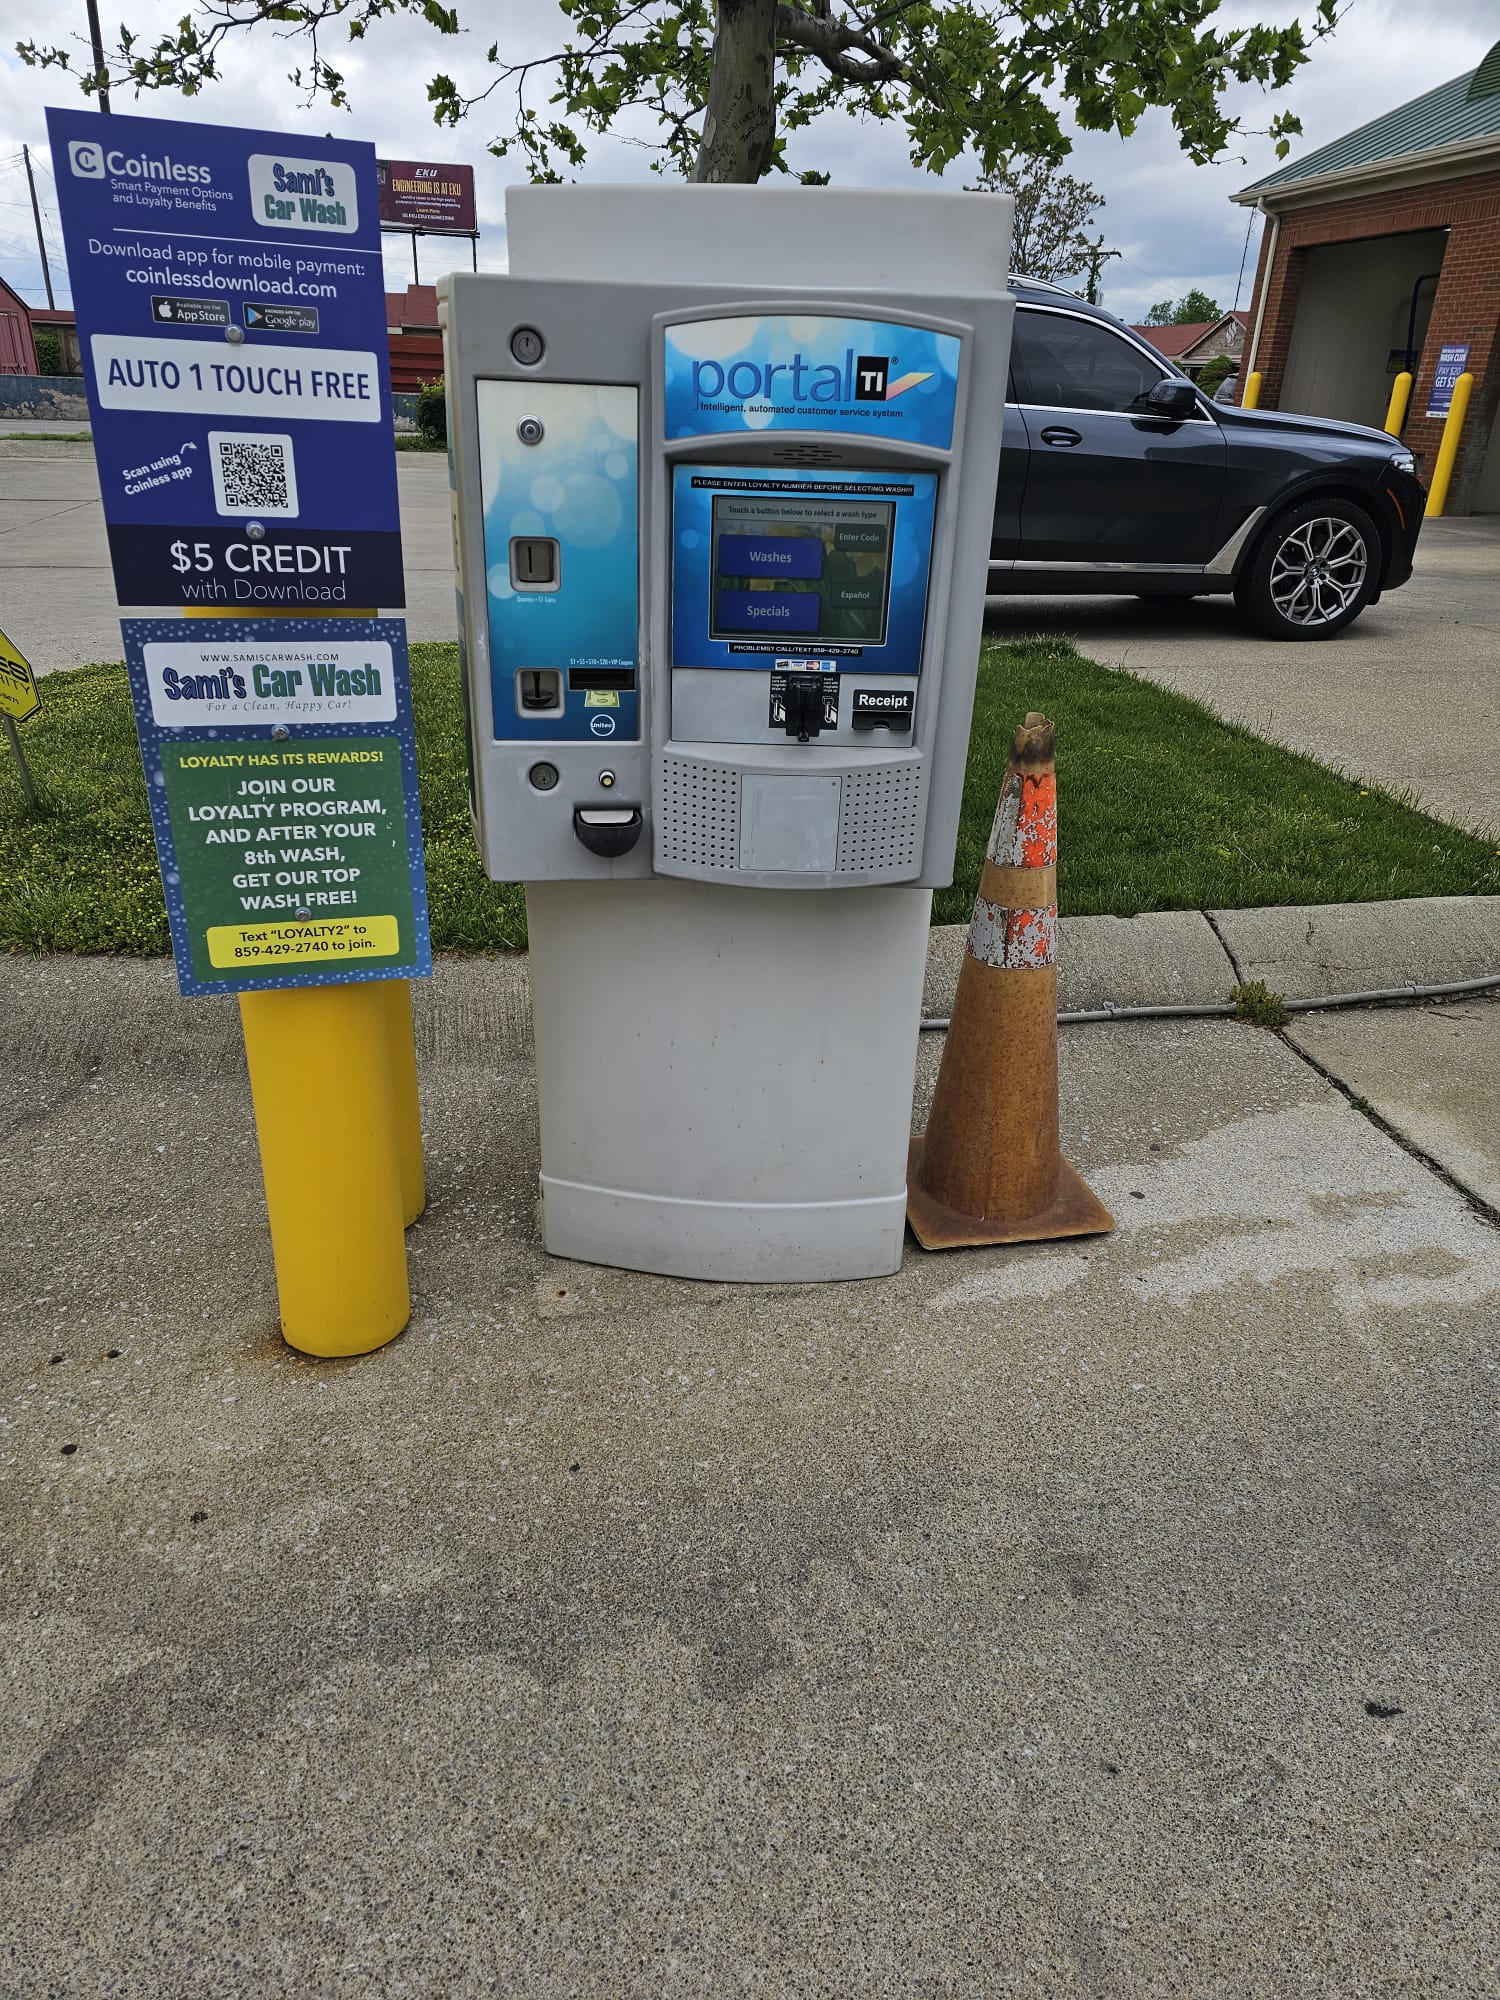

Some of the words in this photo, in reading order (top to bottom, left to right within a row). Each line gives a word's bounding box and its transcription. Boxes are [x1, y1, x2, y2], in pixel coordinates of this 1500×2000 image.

[106, 151, 212, 184] Coinless
[415, 168, 437, 178] EKU
[273, 162, 334, 197] Sami's
[392, 179, 433, 194] ENGINEERING
[433, 182, 440, 194] IS
[441, 183, 449, 195] AT
[449, 184, 461, 196] EKU
[111, 179, 143, 193] Smart
[145, 182, 189, 199] Payment
[192, 186, 233, 201] Options
[113, 192, 132, 204] and
[135, 194, 173, 209] Loyalty
[174, 196, 217, 212] Benefits
[264, 194, 296, 221] Car
[300, 197, 347, 226] Wash
[88, 238, 173, 261] Download
[177, 250, 208, 266] app
[212, 248, 234, 265] for
[238, 251, 291, 270] mobile
[295, 258, 366, 278] payment:
[126, 267, 337, 298] coinlessdownload.com
[176, 301, 202, 309] Available
[177, 309, 197, 322] App
[199, 311, 226, 322] Store
[265, 315, 297, 328] Google
[299, 317, 316, 329] play
[108, 358, 180, 390] AUTO
[189, 363, 202, 391] 1
[210, 364, 302, 397] TOUCH
[311, 370, 370, 400] FREE
[691, 348, 854, 411] portal
[861, 370, 883, 392] TI
[701, 402, 747, 414] Intelligent,
[749, 404, 795, 415] automated
[797, 406, 837, 416] customer
[839, 407, 870, 417] service
[872, 409, 903, 418] system
[122, 464, 150, 481] Scan
[150, 453, 181, 475] using
[124, 473, 170, 495] Coinless
[170, 465, 193, 482] app
[693, 479, 721, 487] PLEASE
[723, 480, 747, 488] ENTER
[748, 481, 780, 489] LOYALTY
[782, 482, 812, 491] NUMBER
[842, 485, 884, 493] SELECTING
[728, 505, 749, 515] Touch
[756, 506, 779, 516] button
[781, 507, 803, 517] below
[804, 508, 812, 517] to
[813, 508, 834, 518] select
[841, 509, 860, 518] wash
[861, 511, 878, 520] type
[839, 532, 859, 542] Enter
[860, 533, 880, 542] Code
[170, 540, 214, 574] $5
[225, 543, 352, 575] CREDIT
[749, 551, 792, 564] Washes
[182, 577, 227, 600] with
[234, 579, 346, 601] Download
[841, 590, 870, 601] Español
[746, 605, 790, 619] Specials
[200, 653, 339, 663] WWW.SAMISCARWASH.COM
[162, 666, 247, 701] Sami's
[253, 663, 302, 698] Car
[308, 663, 382, 697] Wash
[205, 701, 226, 712] For
[229, 703, 239, 711] a
[243, 701, 280, 713] Clean,
[284, 700, 324, 713] Happy
[327, 699, 352, 711] Car!
[858, 694, 908, 709] Receipt
[179, 755, 245, 769] LOYALTY
[248, 754, 279, 766] HAS
[282, 753, 304, 765] ITS
[307, 751, 384, 764] REWARDS!
[237, 779, 287, 797] JOIN
[291, 777, 336, 793] OUR
[188, 803, 275, 822] LOYALTY
[280, 799, 387, 818] PROGRAM,
[205, 828, 251, 844] AND
[256, 825, 318, 843] AFTER
[321, 822, 377, 840] YOUR
[244, 850, 276, 865] 8th
[279, 846, 345, 864] WASH,
[232, 872, 276, 889] GET
[276, 870, 318, 886] OUR
[321, 868, 361, 884] TOP
[240, 893, 301, 911] WASH
[306, 890, 358, 907] FREE!
[239, 931, 267, 943] Text
[353, 924, 367, 935] to
[234, 941, 329, 959] 859-429-2740
[332, 940, 345, 951] to
[348, 938, 376, 952] join.
